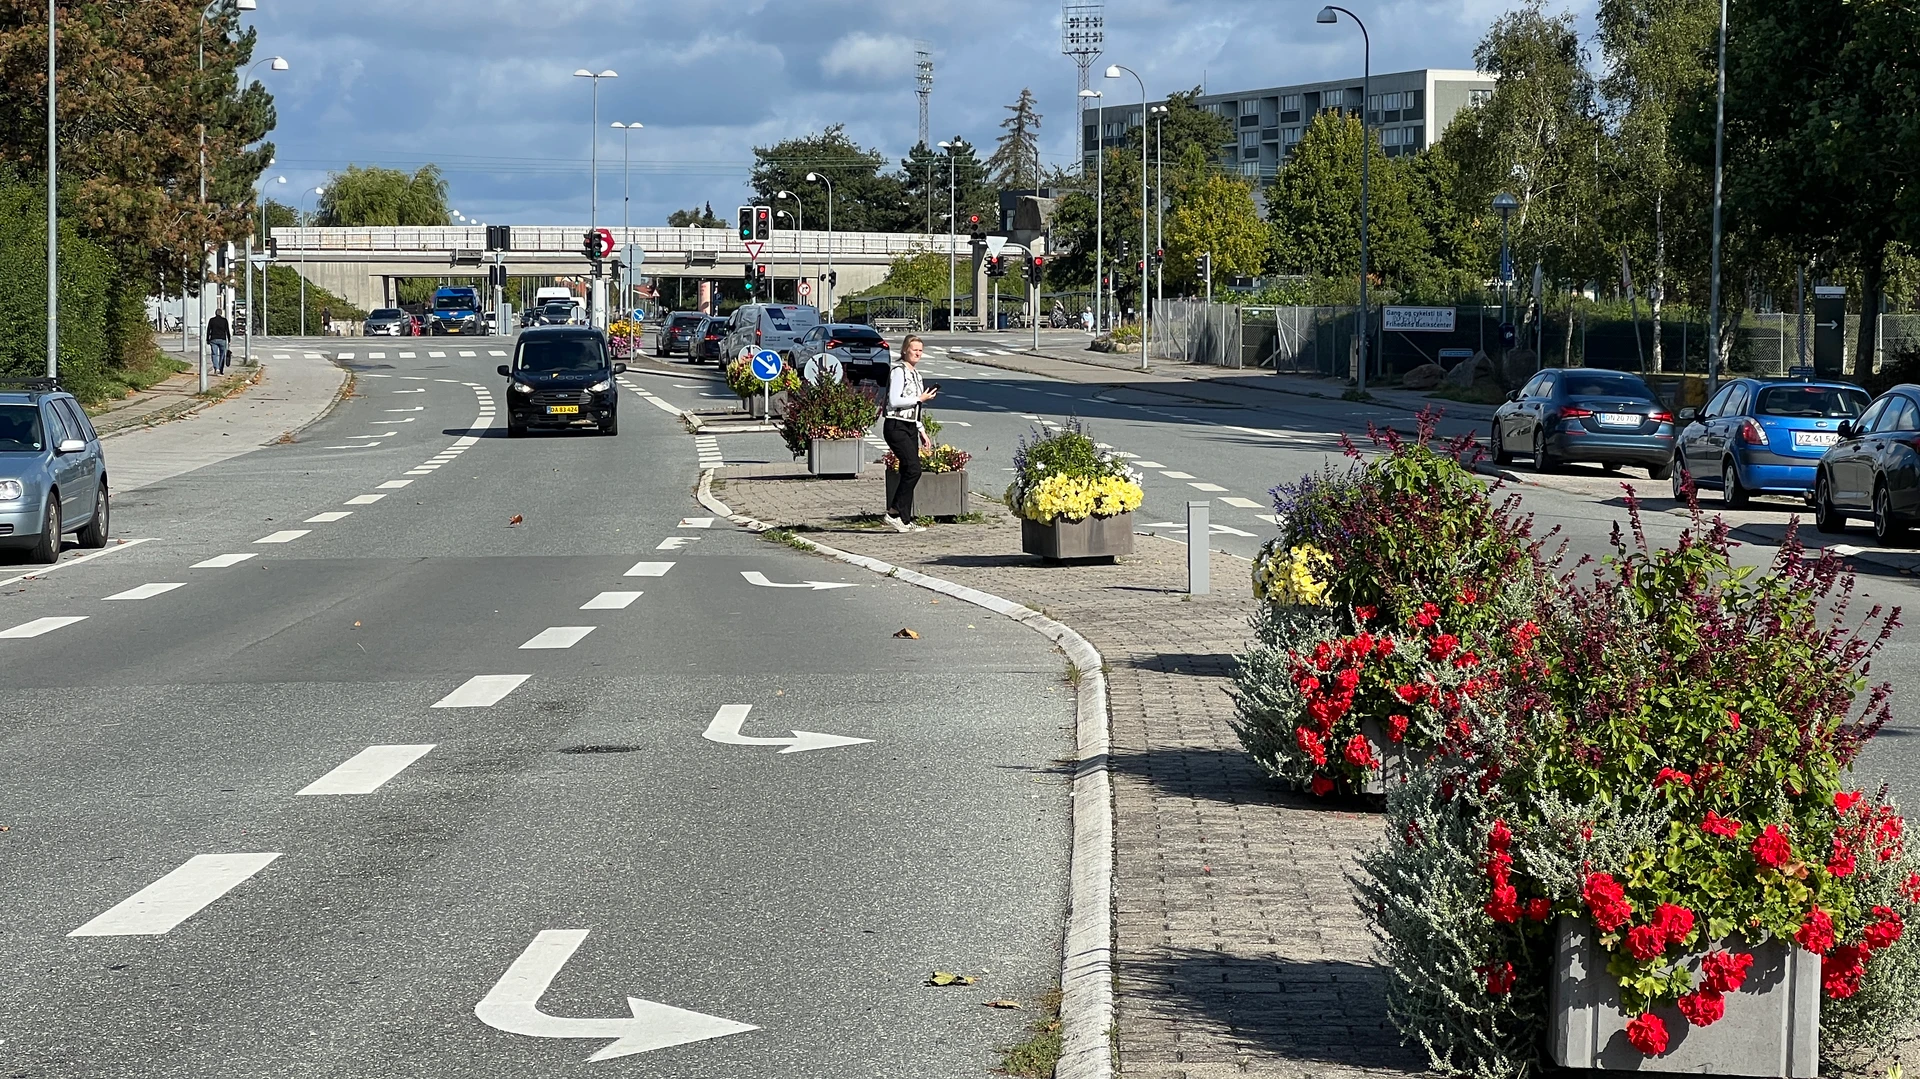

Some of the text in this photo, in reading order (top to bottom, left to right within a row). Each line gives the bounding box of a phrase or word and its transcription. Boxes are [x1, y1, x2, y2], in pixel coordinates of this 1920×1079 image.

[1626, 415, 1638, 423] 702
[1798, 434, 1811, 443] XZ
[1813, 435, 1822, 443] 41
